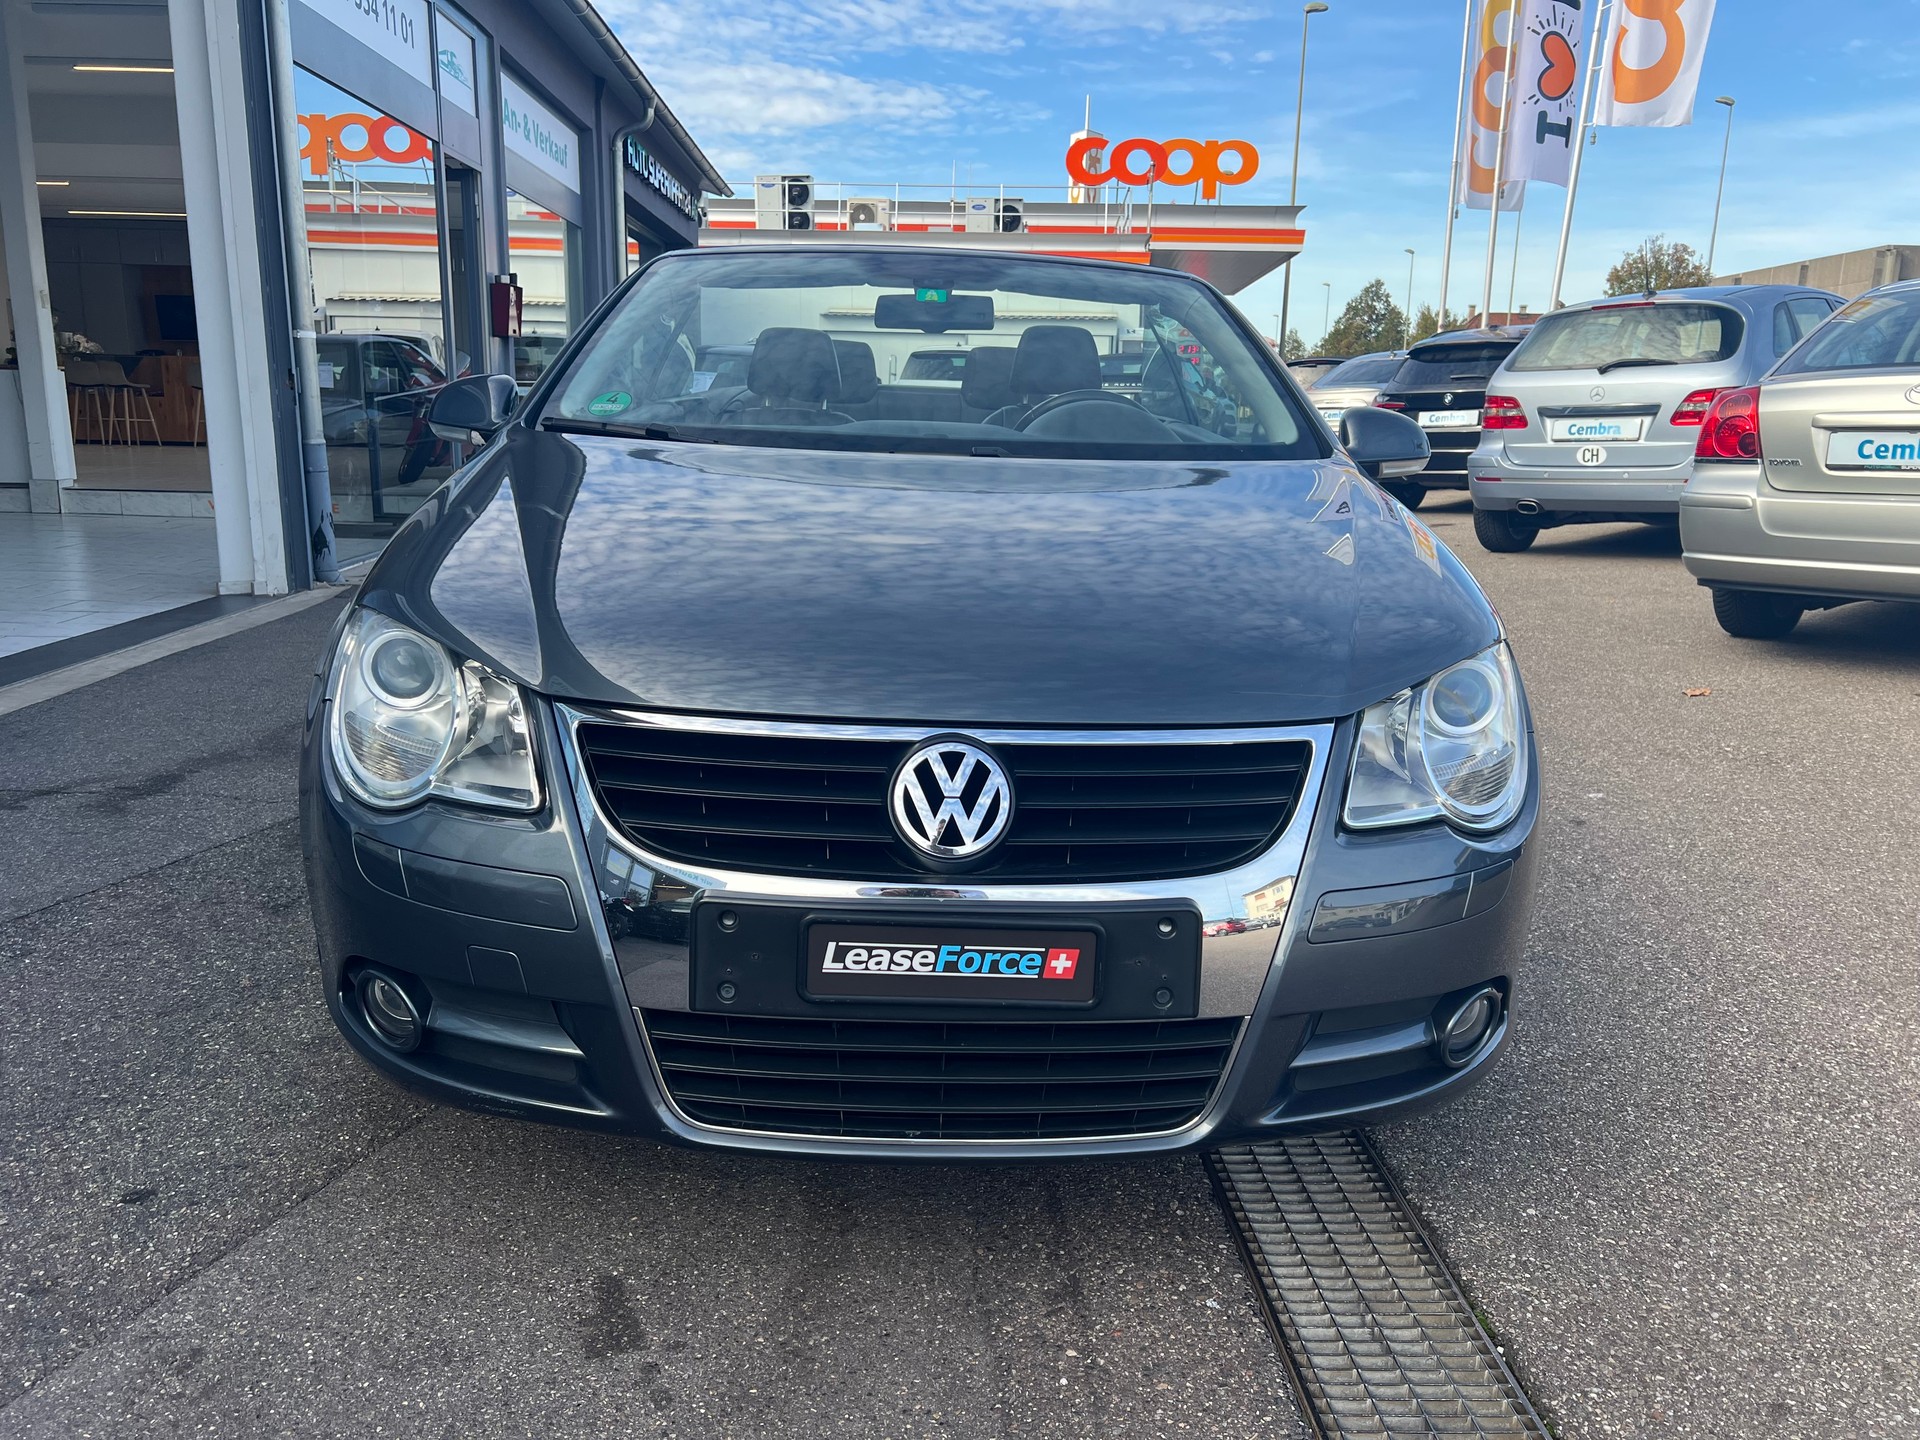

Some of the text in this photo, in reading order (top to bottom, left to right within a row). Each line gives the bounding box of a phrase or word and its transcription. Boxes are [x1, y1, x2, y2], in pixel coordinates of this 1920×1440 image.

[400, 12, 414, 49] 01
[503, 98, 567, 168] An- & Verkauf
[1065, 136, 1260, 200] coop
[1429, 413, 1467, 423] Cembra
[1567, 422, 1622, 436] Cembra
[1582, 448, 1600, 463] CH
[1857, 439, 1920, 460] Cem
[1768, 458, 1803, 466] TOYOTA
[822, 941, 1043, 975] LeaseForce
